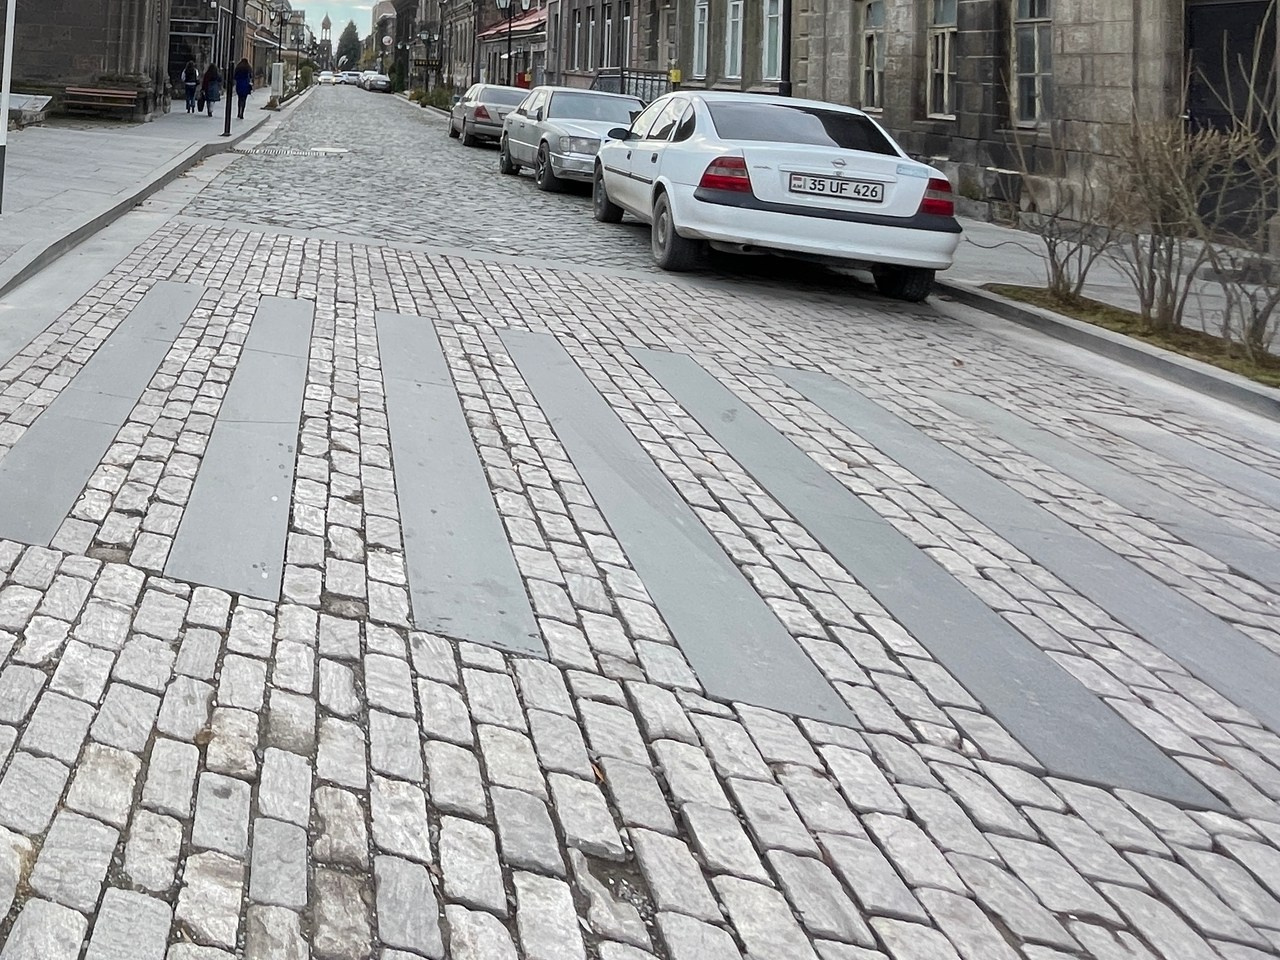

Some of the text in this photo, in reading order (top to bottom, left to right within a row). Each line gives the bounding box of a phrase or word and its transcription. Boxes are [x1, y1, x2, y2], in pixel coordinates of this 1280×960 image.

[809, 178, 878, 198] 35 UF 426
